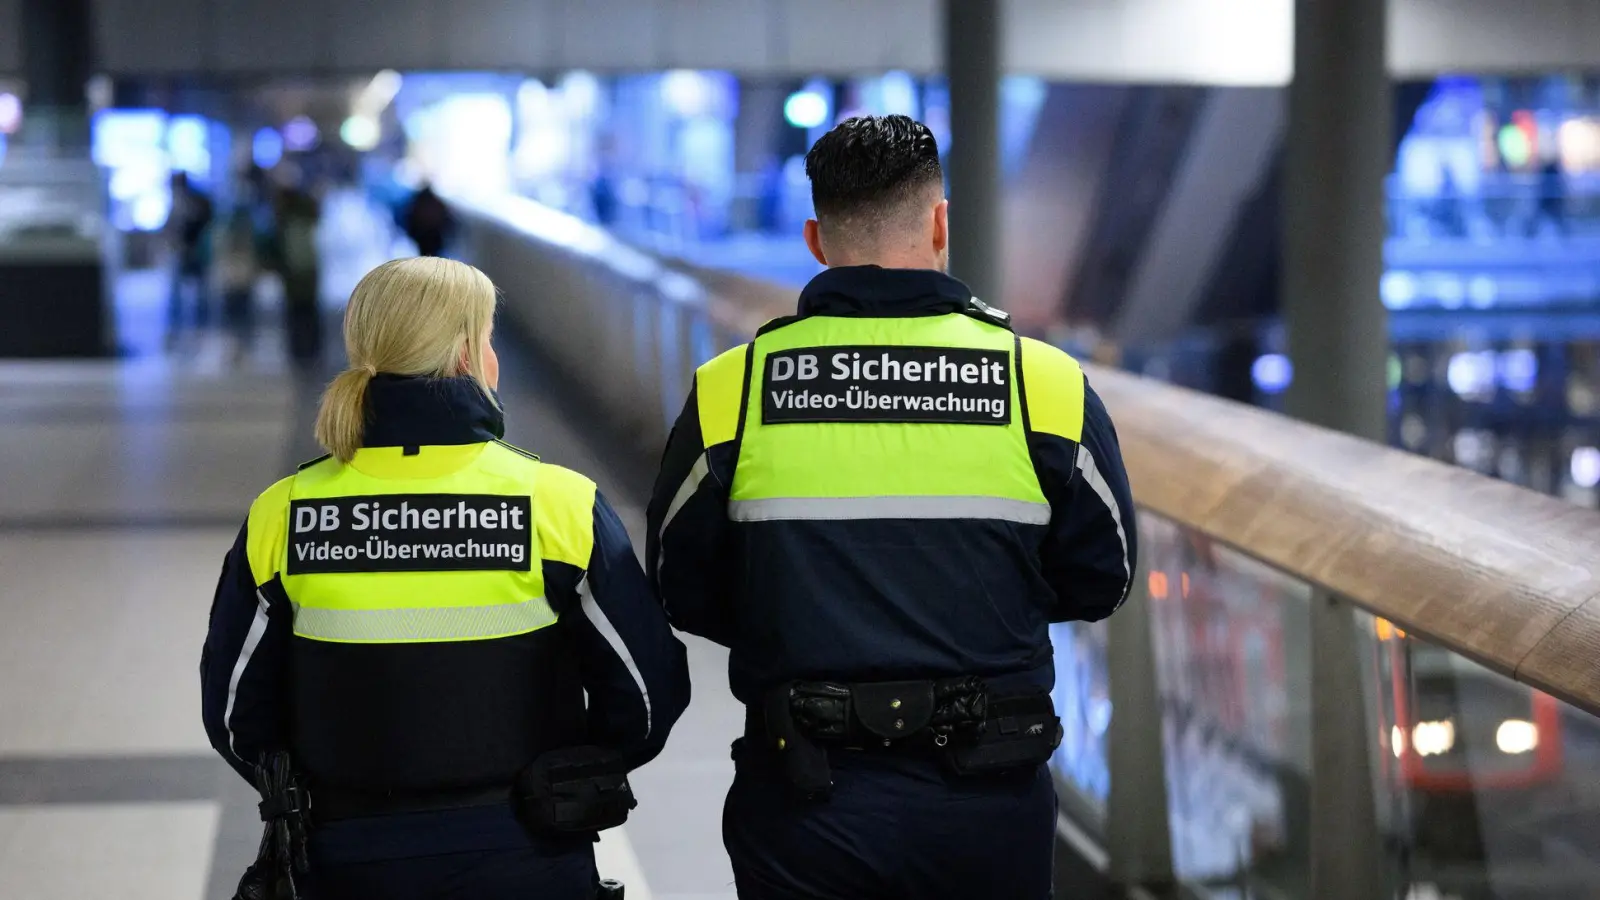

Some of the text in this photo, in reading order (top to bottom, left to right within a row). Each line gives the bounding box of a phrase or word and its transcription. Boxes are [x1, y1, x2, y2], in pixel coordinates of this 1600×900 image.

[771, 352, 1005, 385] DB Sicherheit
[771, 385, 1005, 418] Video-Überwachung
[295, 501, 524, 533] DB Sicherheit
[295, 536, 524, 563] Video-Überwachung
